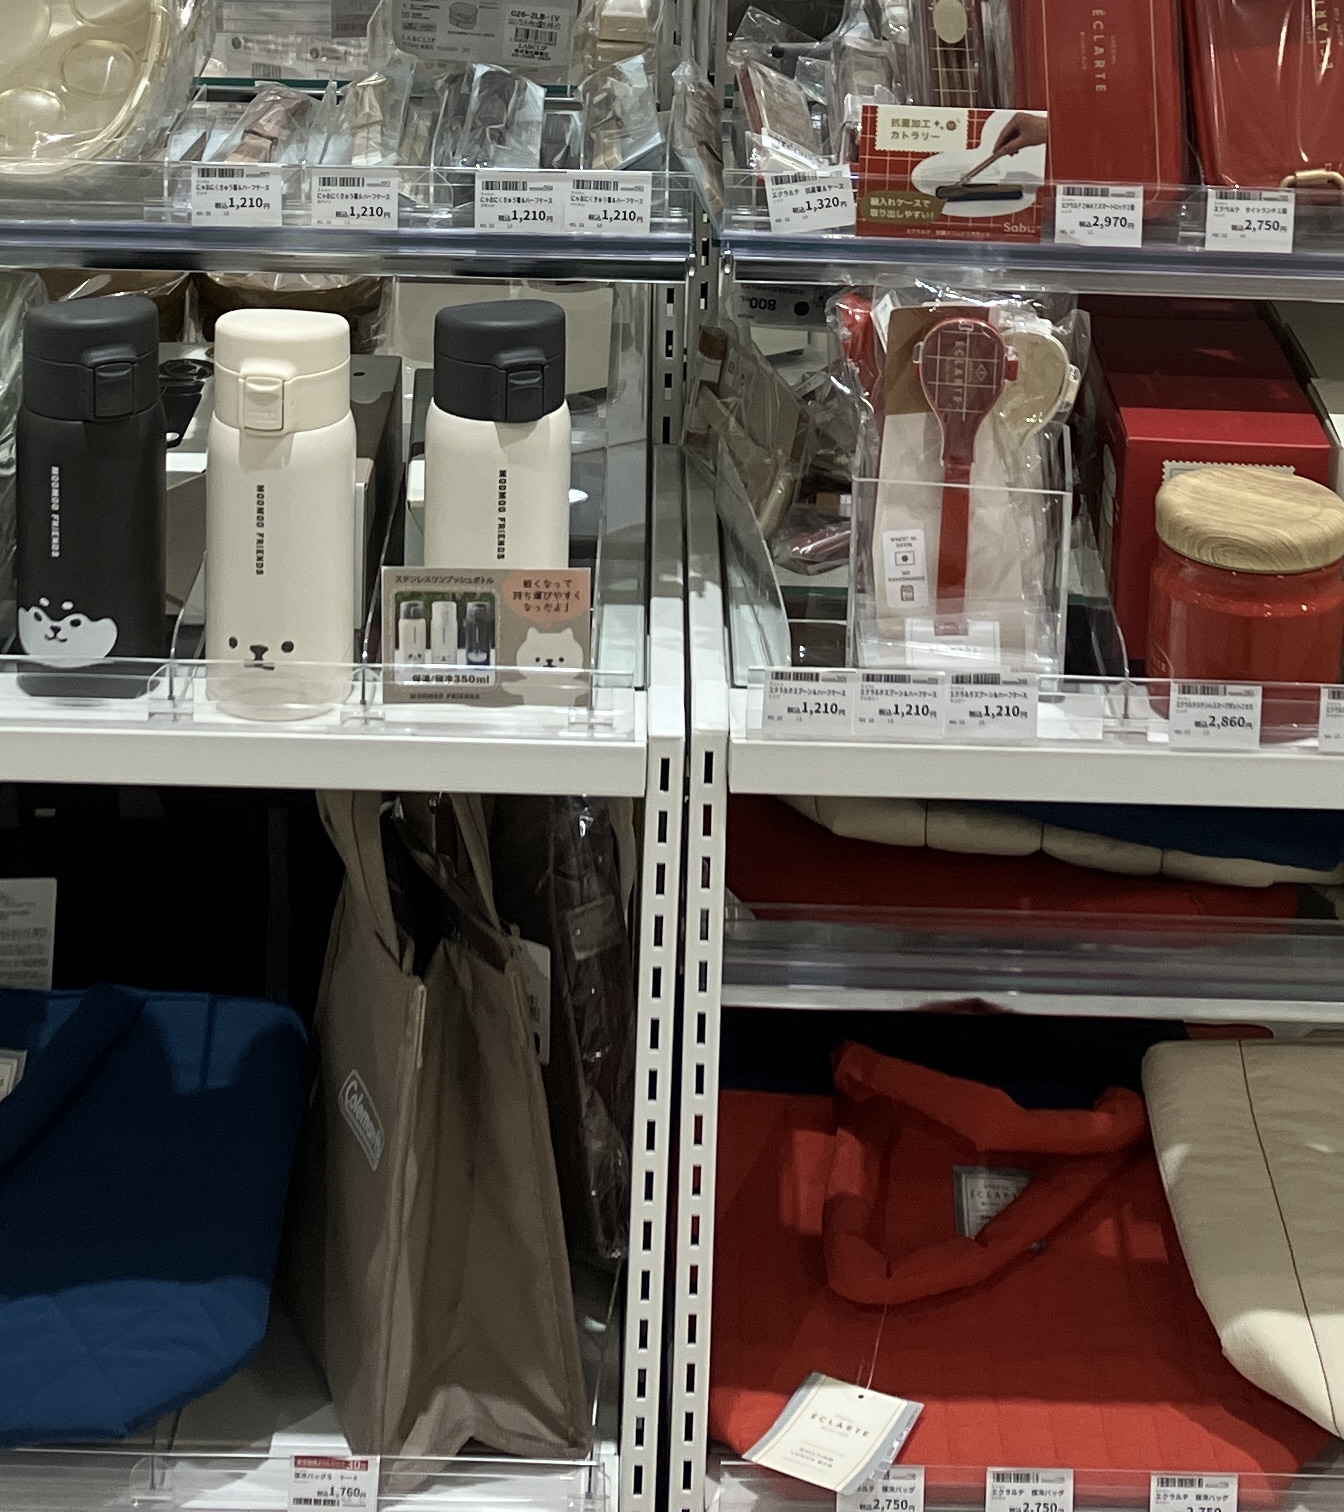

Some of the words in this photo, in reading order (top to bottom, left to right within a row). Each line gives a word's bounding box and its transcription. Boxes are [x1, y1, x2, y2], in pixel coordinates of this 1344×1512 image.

[1092, 8, 1107, 93] ÉCLARTE
[889, 130, 941, 141] カトラリー
[214, 196, 271, 211] 税込1,210円
[792, 196, 848, 216] 税込1,320円
[334, 204, 391, 220] 税込1,210円
[497, 208, 554, 223] 税込1,210円
[588, 208, 644, 223] 税込1,210円
[1002, 222, 1037, 234] Sabu
[1078, 214, 1136, 230] 税込2,970円
[1231, 218, 1288, 233] 税込2,750円
[496, 516, 507, 560] FRIENDS
[255, 532, 265, 576] FRIENDS
[786, 701, 846, 717] 税込1,210円
[878, 703, 938, 719] 税込1,210円
[968, 703, 1029, 720] 税込1,210円
[1194, 714, 1254, 731] 税込2,860円
[810, 1411, 870, 1438] ÉCLARTE
